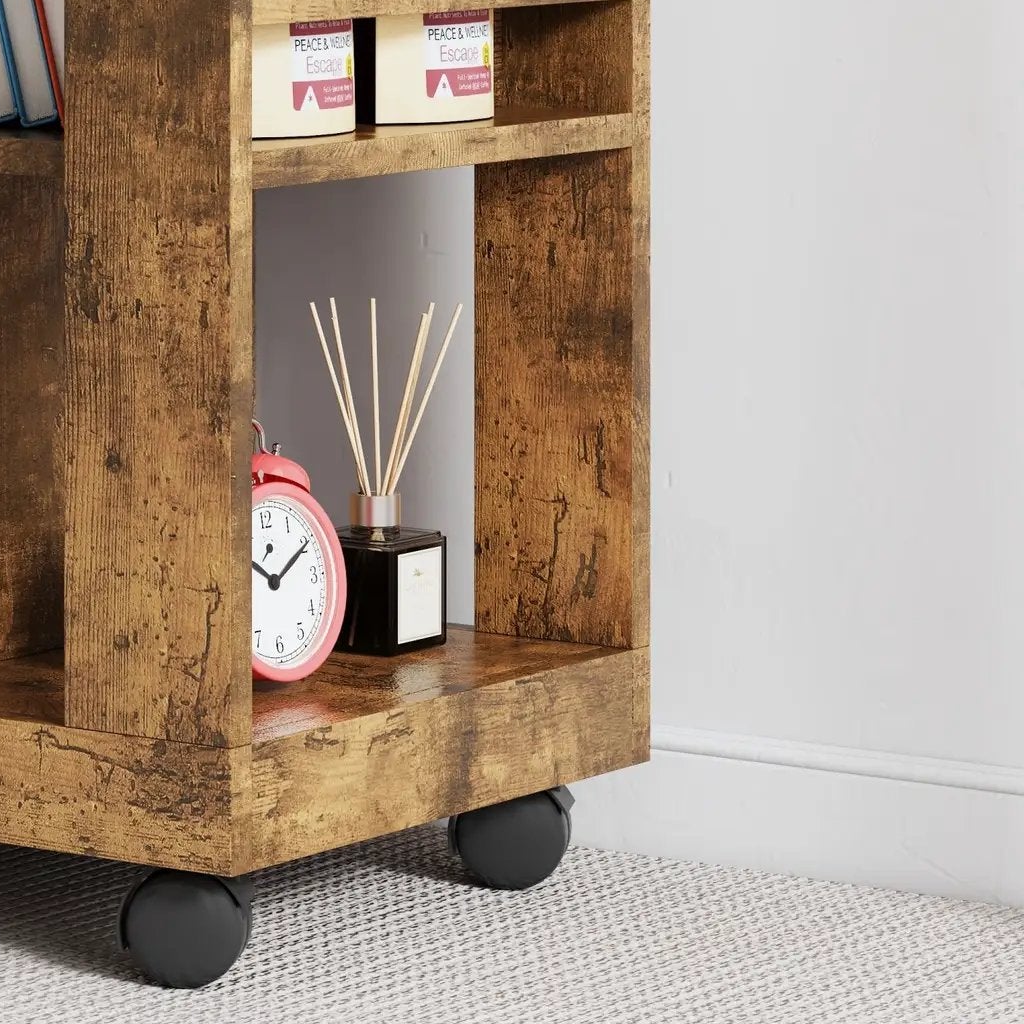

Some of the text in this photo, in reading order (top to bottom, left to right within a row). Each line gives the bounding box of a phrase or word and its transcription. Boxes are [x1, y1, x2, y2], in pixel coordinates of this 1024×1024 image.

[428, 25, 489, 41] PEACE & WELLNE
[294, 35, 351, 52] PEACE & WELLNE
[440, 45, 479, 64] Escape
[306, 56, 343, 76] Escape
[259, 510, 272, 529] 12
[285, 516, 290, 534] 1
[310, 566, 318, 584] 3
[307, 599, 315, 616] 4
[254, 630, 262, 648] 7
[297, 622, 305, 640] 5
[275, 635, 284, 654] 6
